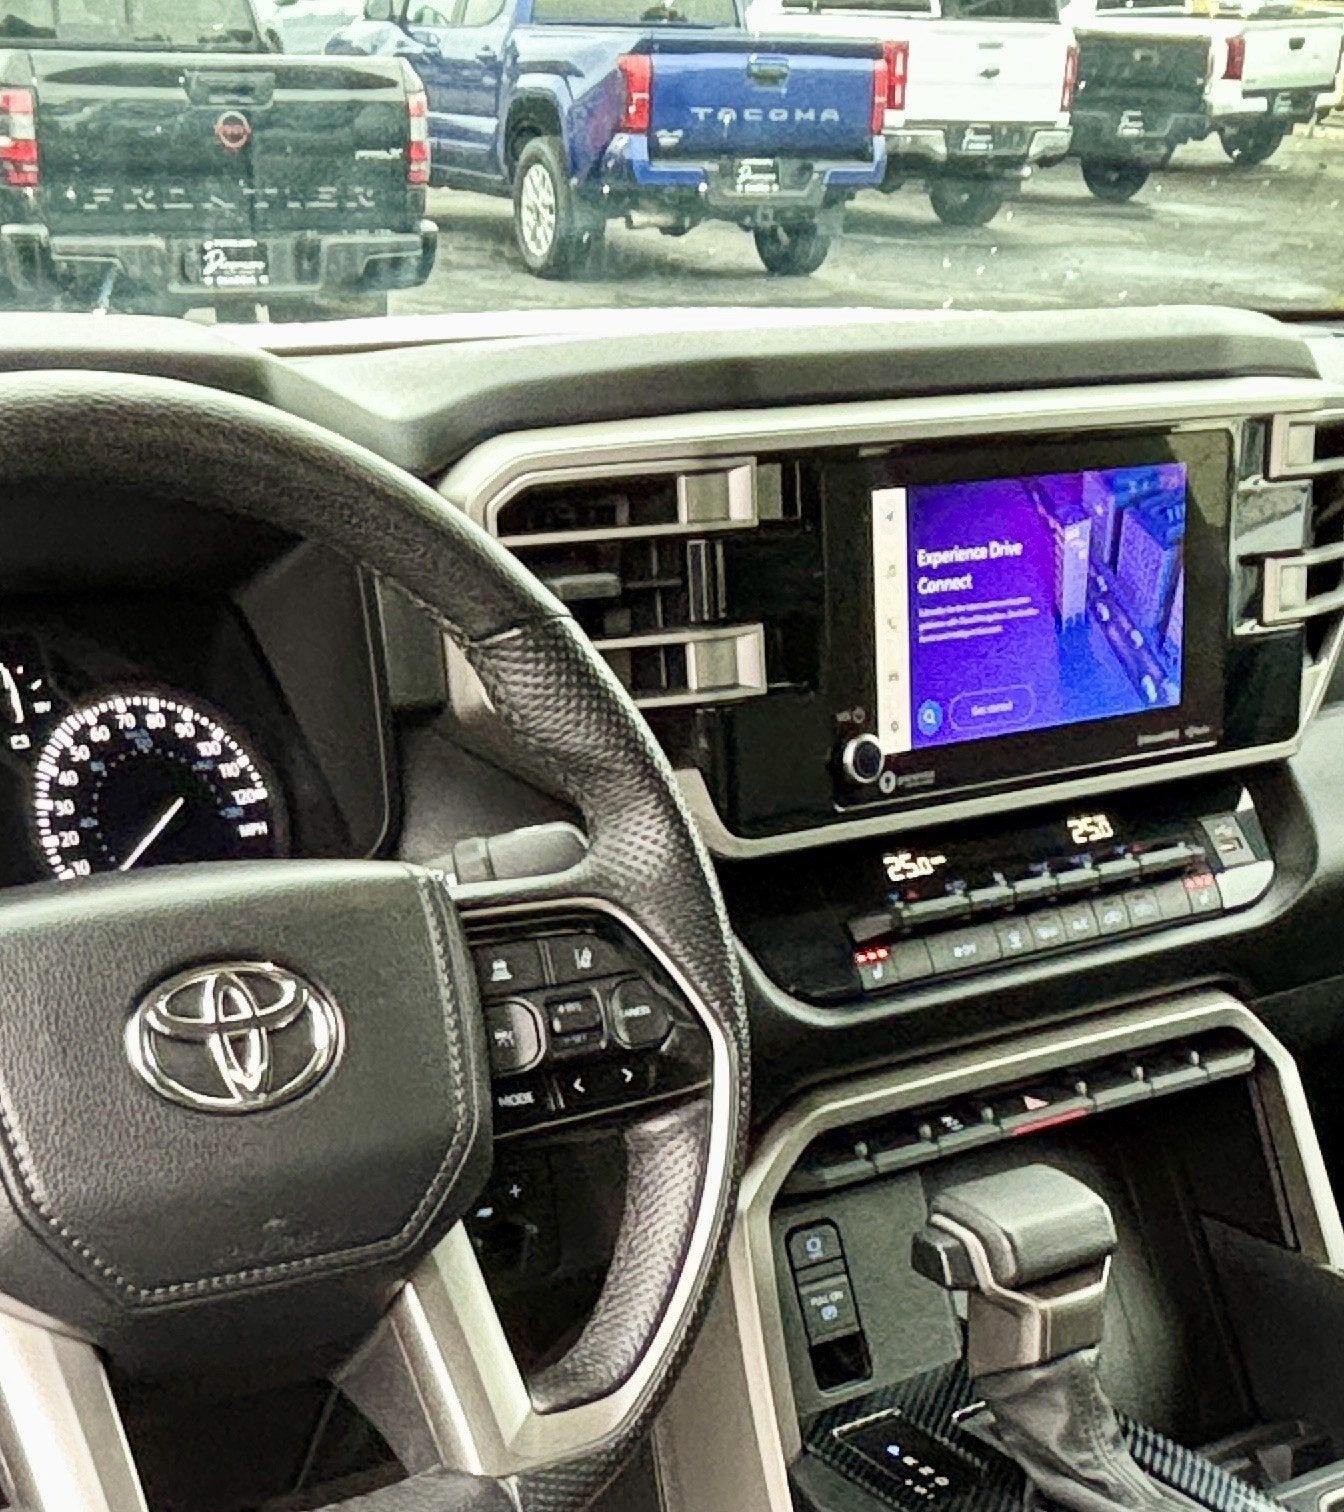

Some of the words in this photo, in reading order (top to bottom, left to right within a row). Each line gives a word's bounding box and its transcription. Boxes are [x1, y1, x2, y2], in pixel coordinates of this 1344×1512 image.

[688, 106, 840, 123] TACOMA
[916, 545, 988, 569] Experience
[989, 540, 1023, 559] Drive
[917, 573, 973, 594] Connect
[115, 712, 136, 730] 70
[145, 712, 166, 730] 80
[90, 725, 110, 743] 60
[174, 721, 196, 739] 90
[69, 744, 91, 763] 50
[196, 740, 222, 757] 100
[58, 770, 79, 787] 40
[218, 762, 241, 779] 110
[231, 788, 256, 806] 120
[55, 799, 75, 816] 30
[59, 830, 80, 847] 20
[73, 859, 91, 876] 10
[498, 1091, 535, 1107] MODE
